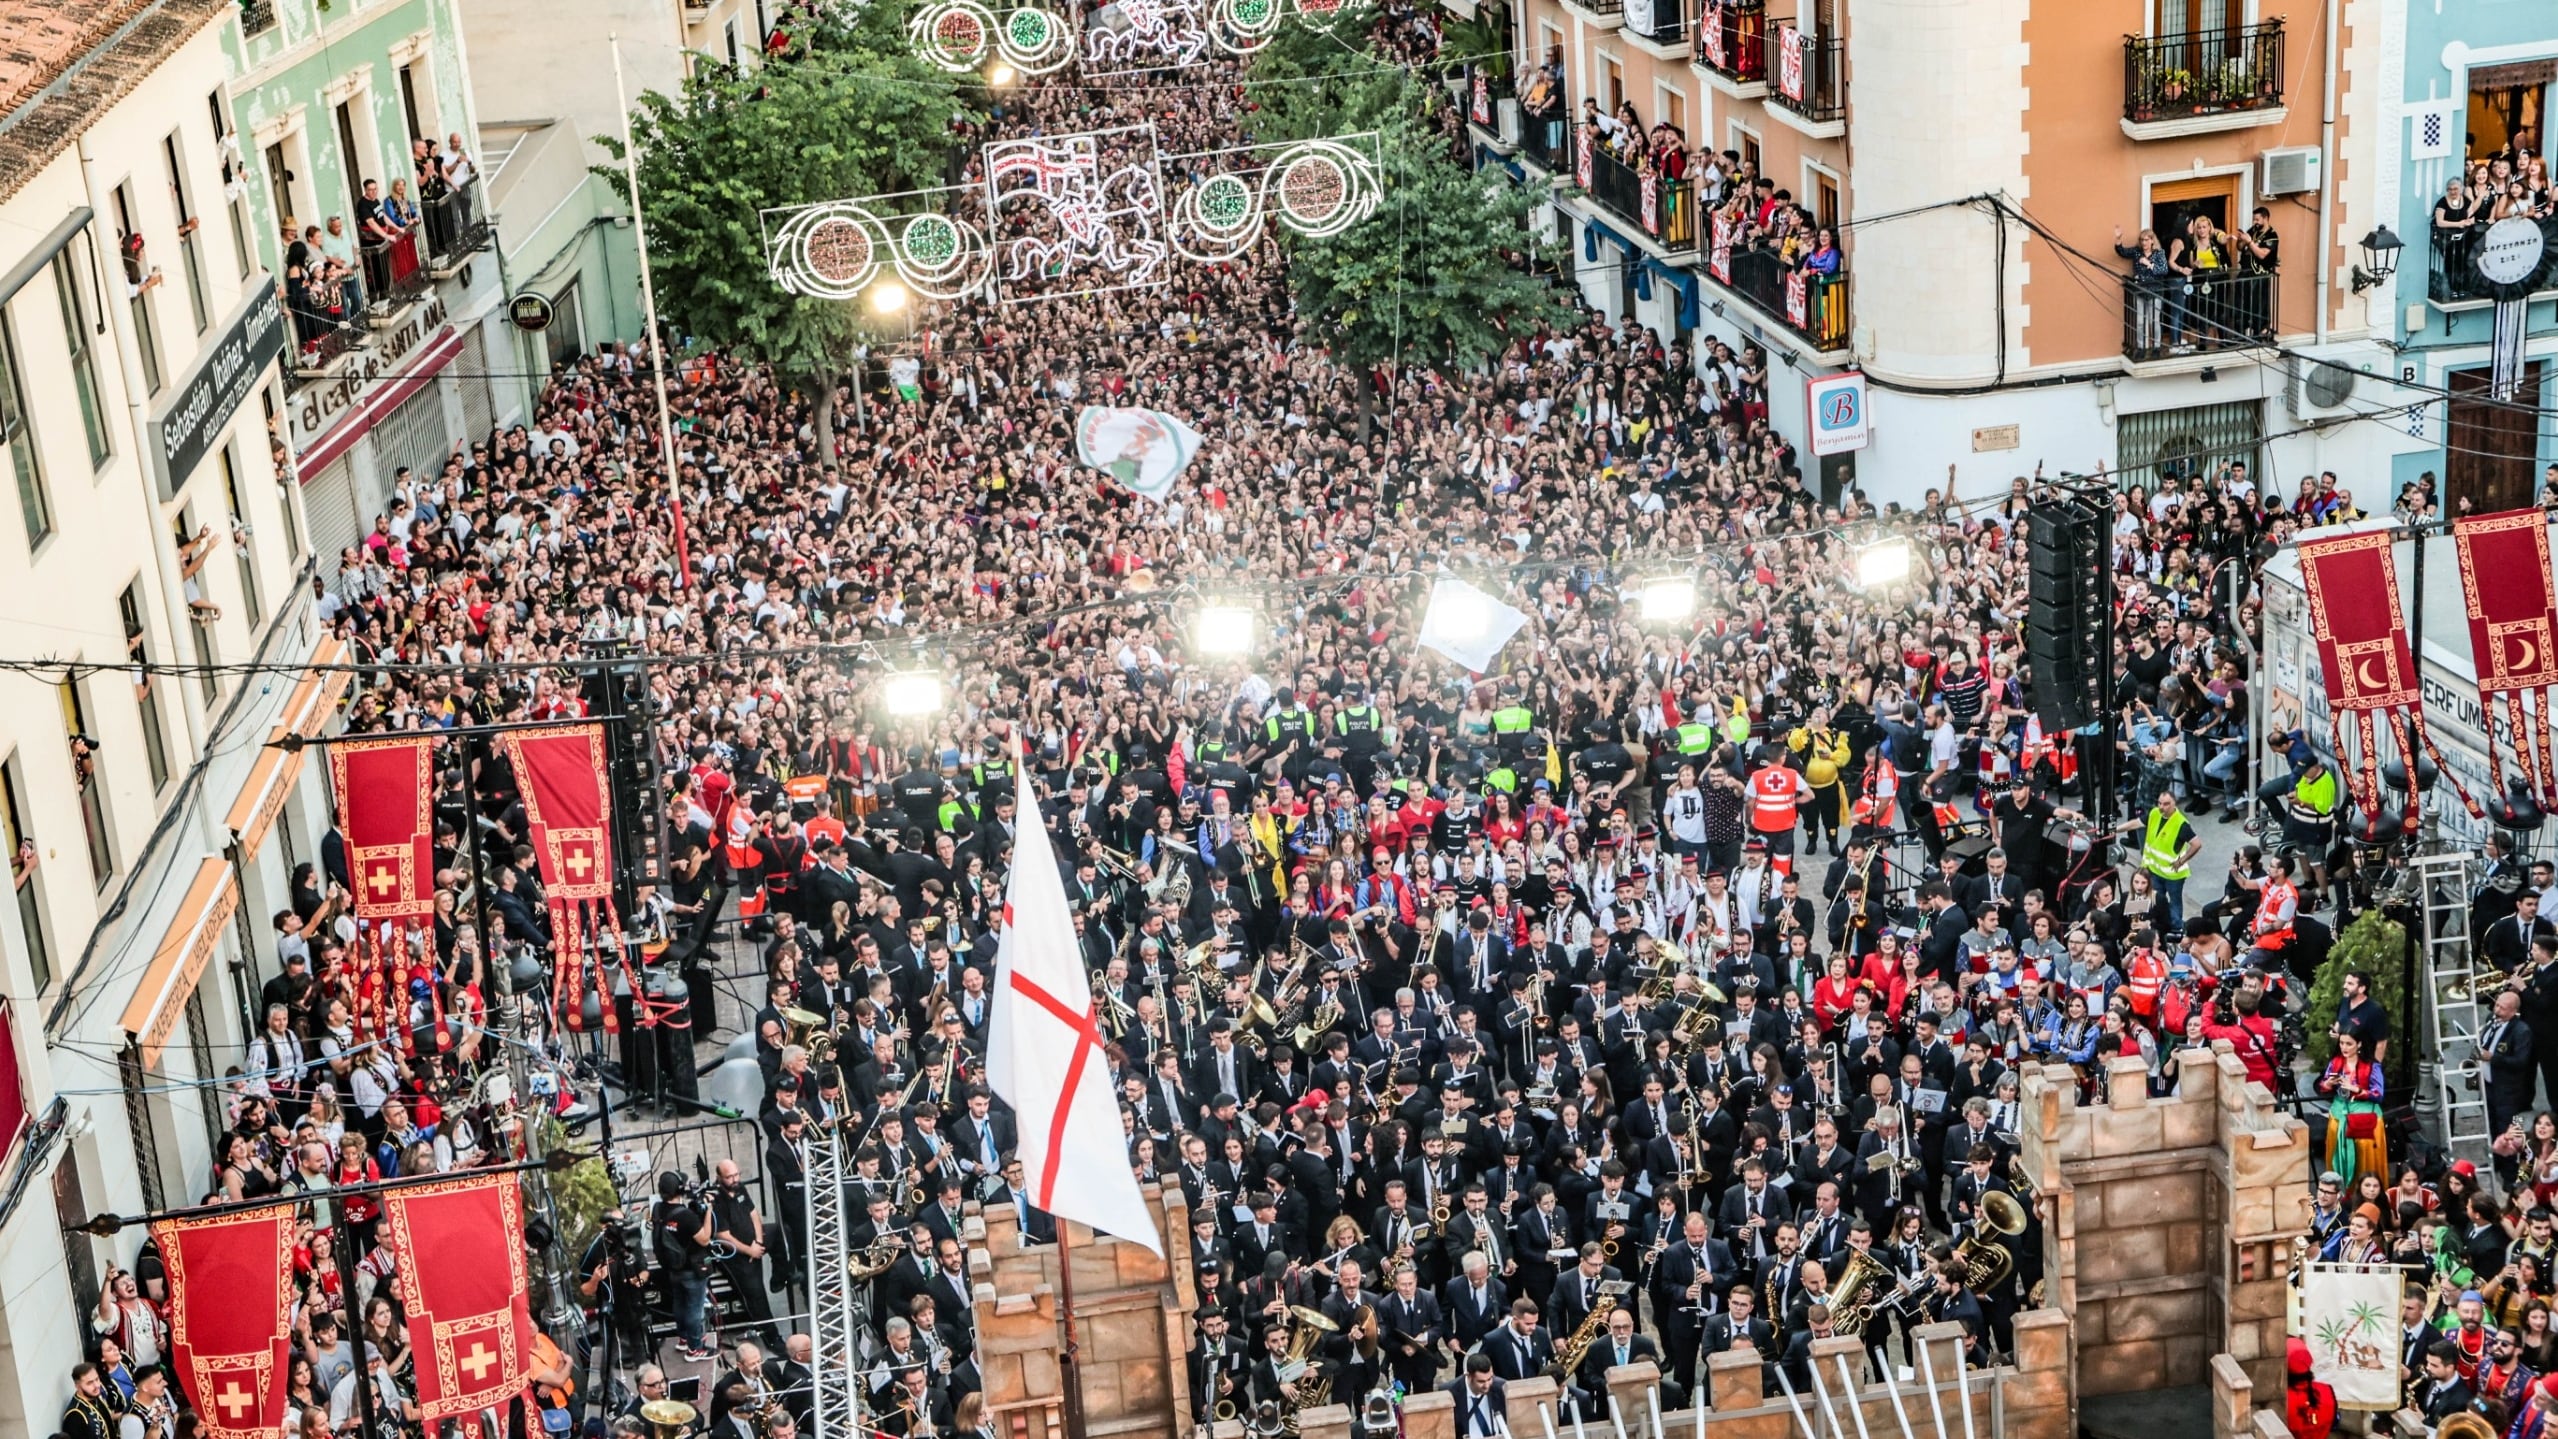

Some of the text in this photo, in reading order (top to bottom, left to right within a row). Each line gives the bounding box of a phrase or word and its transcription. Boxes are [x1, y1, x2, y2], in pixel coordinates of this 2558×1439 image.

[164, 292, 279, 460] Sebastián Ibáñez Jiménez
[302, 298, 448, 431] el café de SANTA ANA
[2403, 367, 2415, 382] B
[203, 390, 236, 448] ARQUITECTO
[1825, 392, 1854, 424] B
[2419, 675, 2517, 749] ERFUMERI
[150, 973, 191, 1050] CAFETERIA
